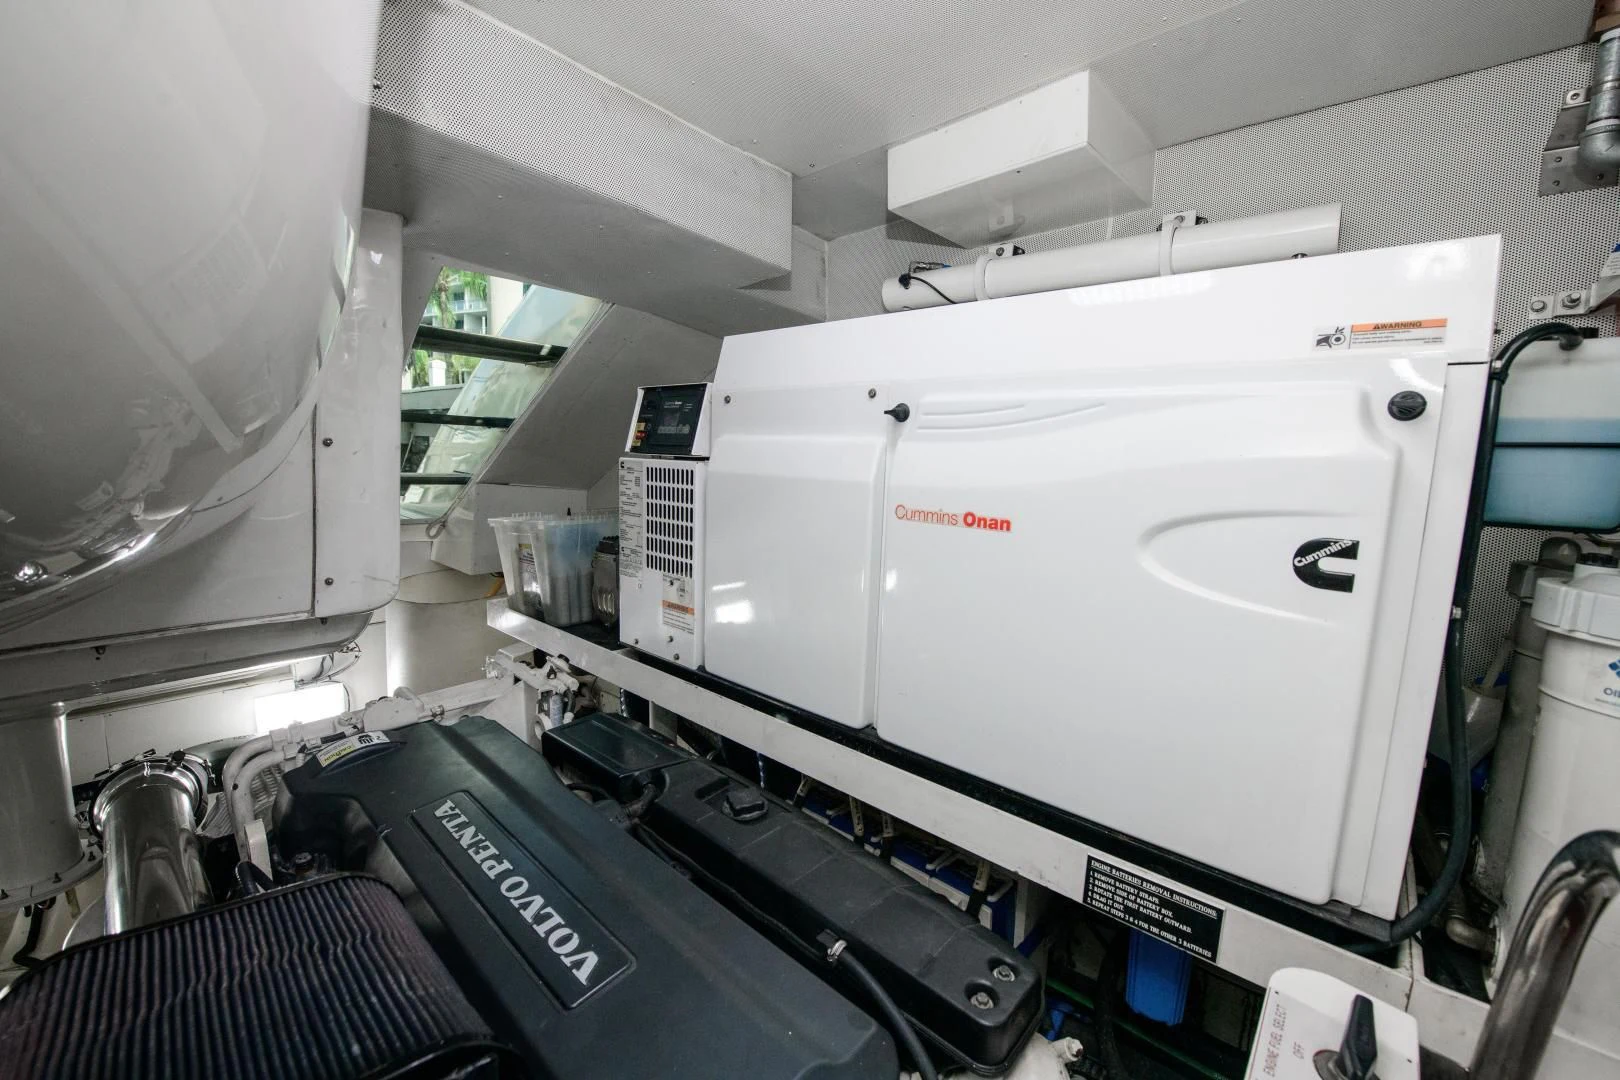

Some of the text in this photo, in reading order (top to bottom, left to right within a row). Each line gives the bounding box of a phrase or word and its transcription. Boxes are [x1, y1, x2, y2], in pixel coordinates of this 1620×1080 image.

[1380, 320, 1423, 329] WARNING
[895, 504, 1011, 532] Cummins Onan
[1293, 540, 1354, 567] Cummins
[433, 799, 600, 986] VOLVO PENTA
[1091, 860, 1111, 872] ENGINE
[1112, 868, 1142, 885] BATTERIES
[1142, 881, 1172, 898] REMOVAL
[1094, 872, 1115, 885] REMOVE
[1115, 881, 1139, 894] BATTERY
[1094, 879, 1115, 892] REMOVE
[1136, 898, 1160, 912] BATTERY
[1093, 886, 1113, 898] ROTATE
[1113, 894, 1124, 904] THE
[1124, 900, 1139, 910] FIRST
[1139, 906, 1163, 921] BATTERY
[1091, 899, 1110, 912] REPEAT
[1110, 908, 1125, 919] STEPS
[1139, 920, 1149, 930] FOR
[1149, 925, 1160, 935] THE
[1160, 930, 1177, 943] OTHER
[1182, 940, 1212, 958] BATTERIES
